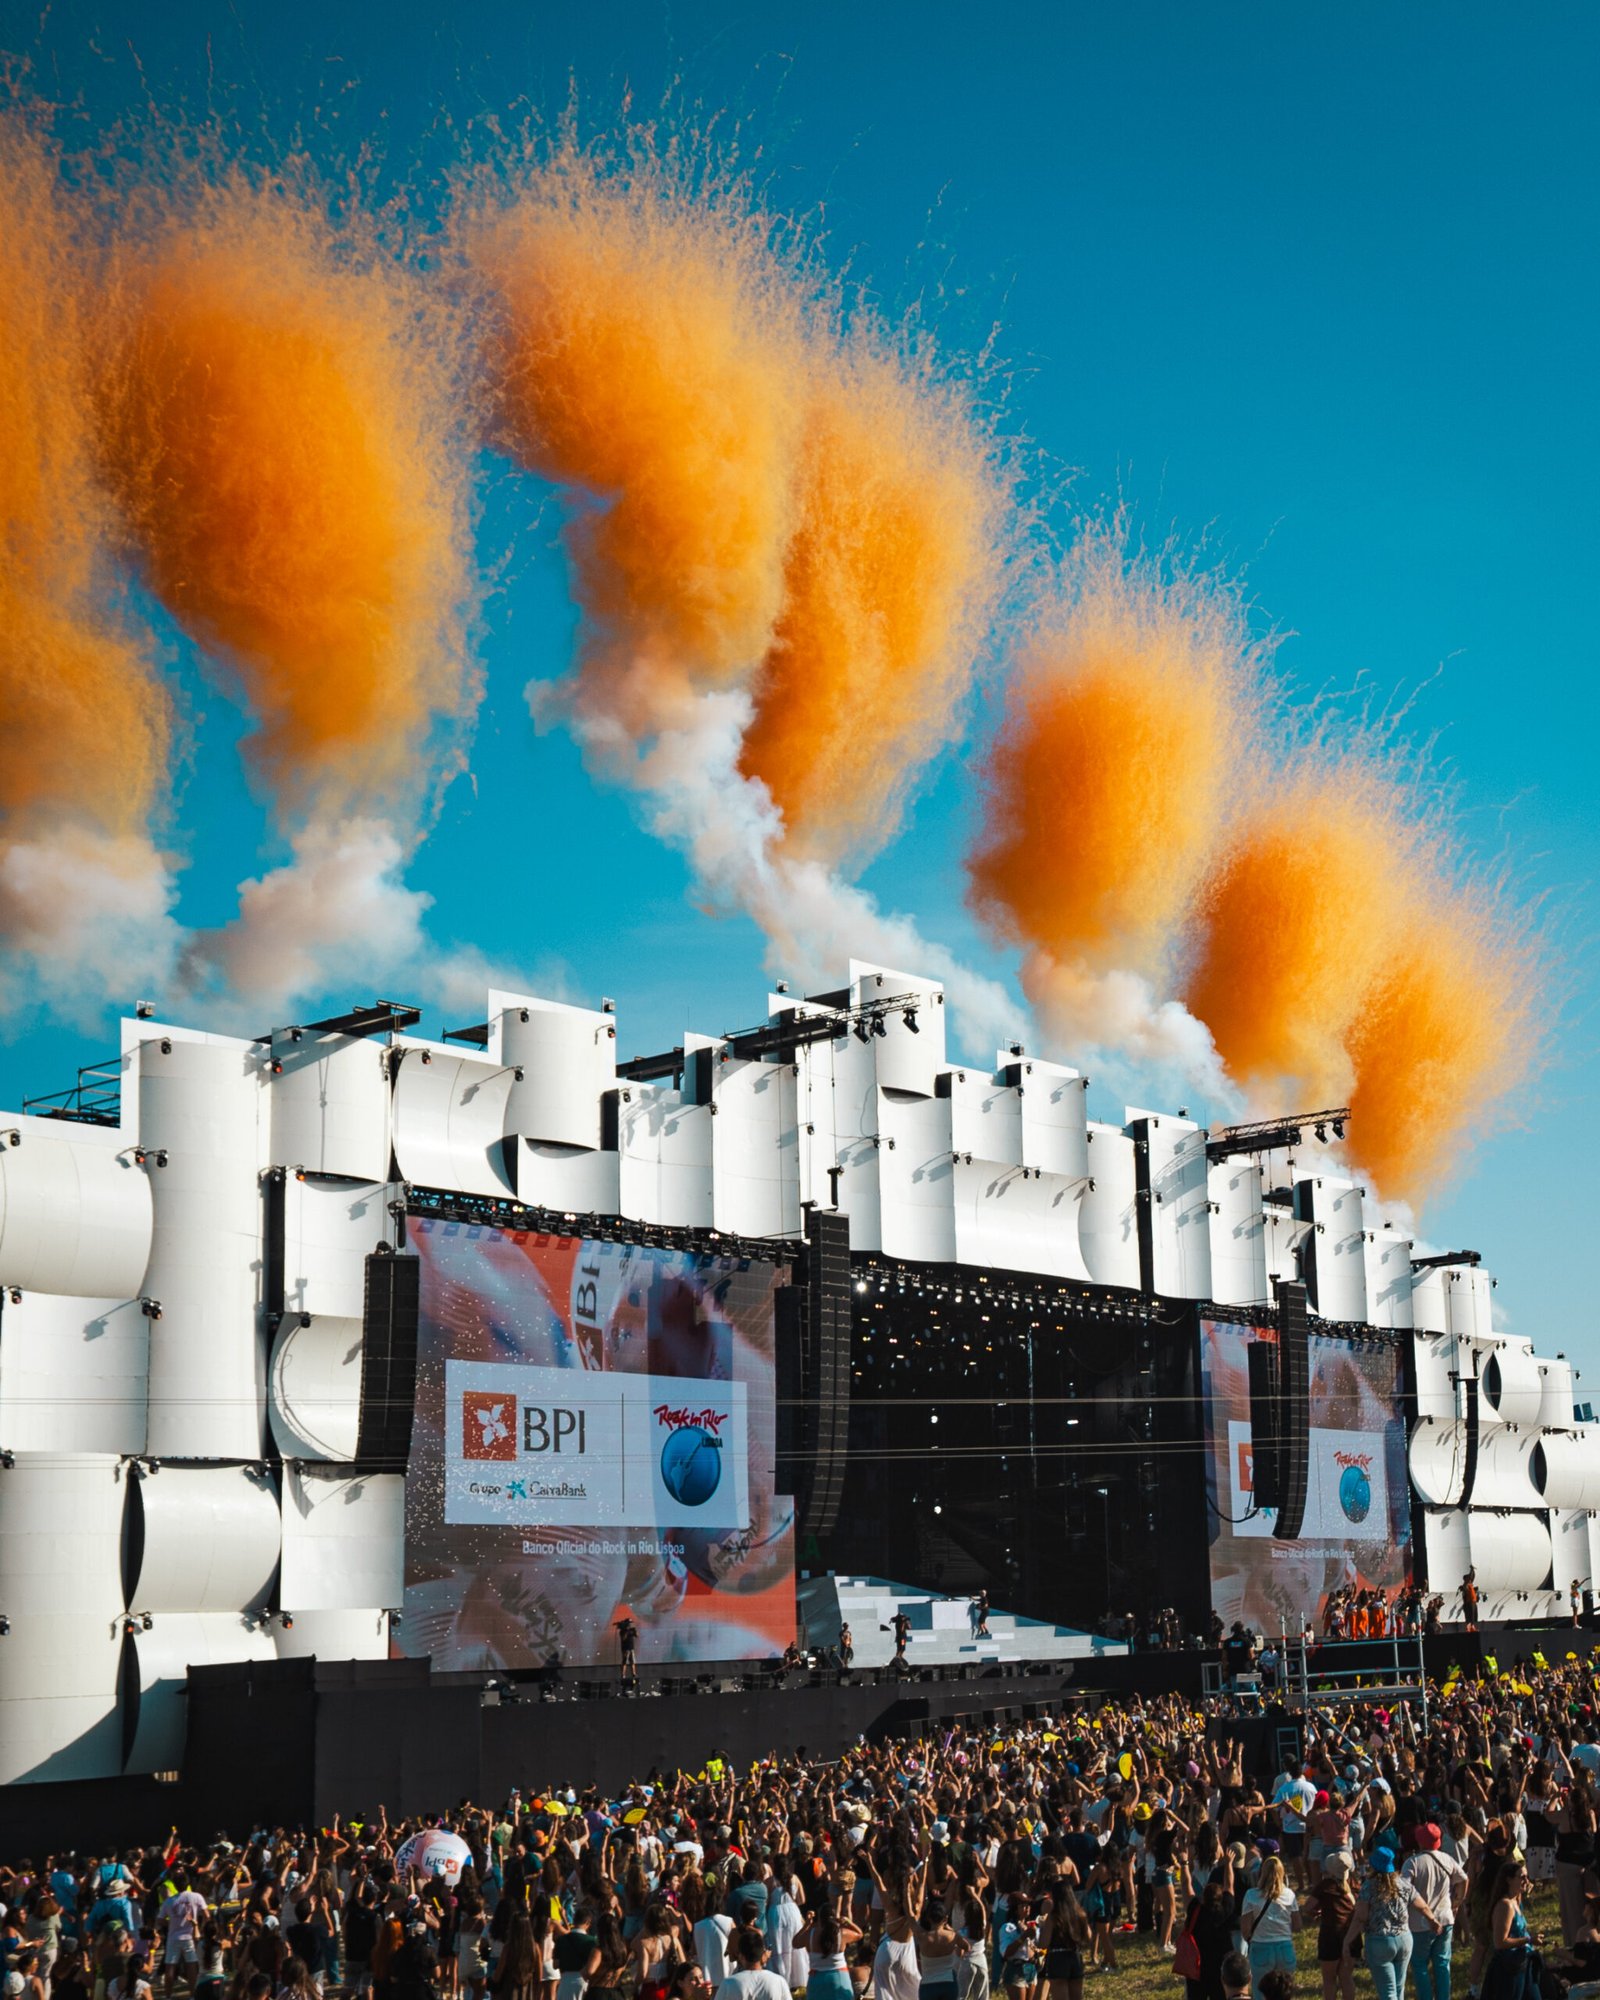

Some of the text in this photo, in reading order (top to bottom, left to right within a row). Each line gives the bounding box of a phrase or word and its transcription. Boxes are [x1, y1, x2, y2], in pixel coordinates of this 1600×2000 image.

[523, 1406, 586, 1454] BPI
[653, 1404, 690, 1431] Rock
[700, 1409, 728, 1435] Rio
[469, 1480, 587, 1497] Grupo CaixaBank
[522, 1540, 685, 1555] Banco Oficial do Rock in Rio Lisboa
